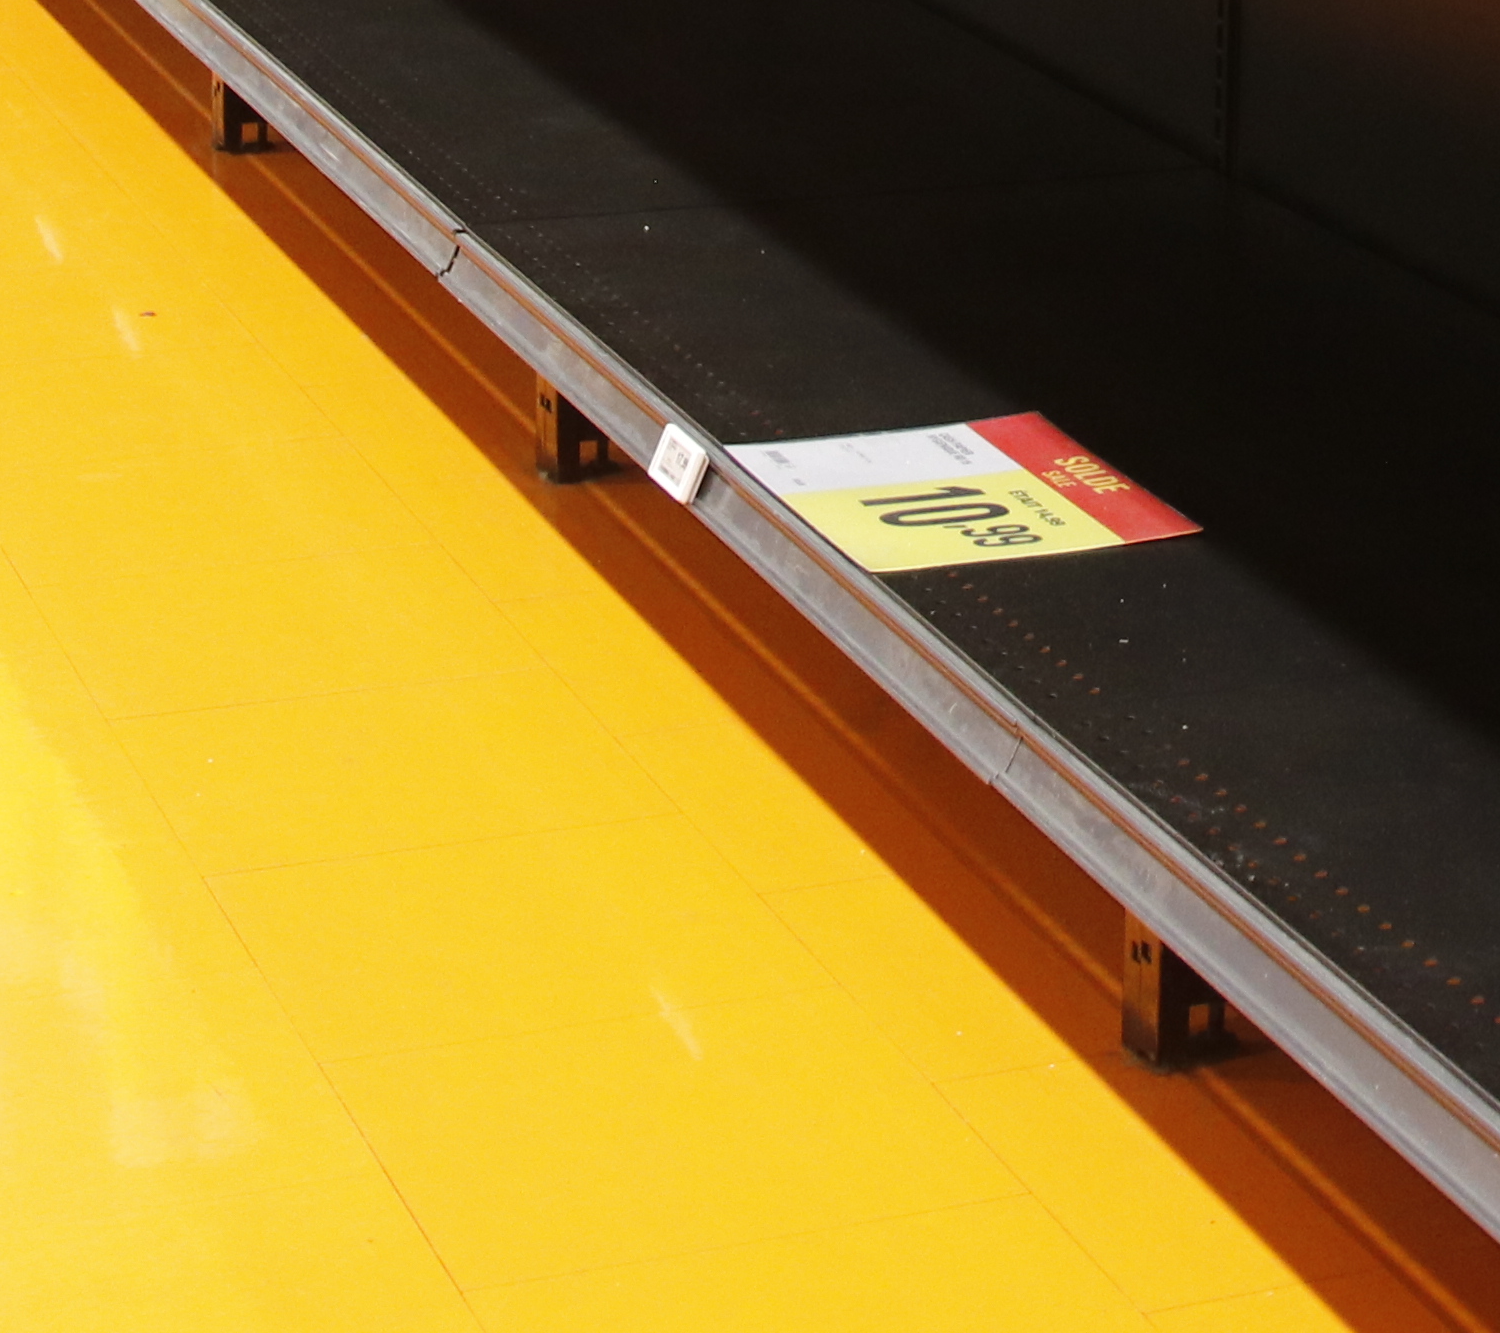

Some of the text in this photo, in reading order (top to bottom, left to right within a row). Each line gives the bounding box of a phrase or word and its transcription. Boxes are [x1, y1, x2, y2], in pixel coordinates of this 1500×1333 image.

[1041, 470, 1077, 490] SALE
[1053, 453, 1130, 496] SOLDE
[858, 485, 1043, 549] 10,99
